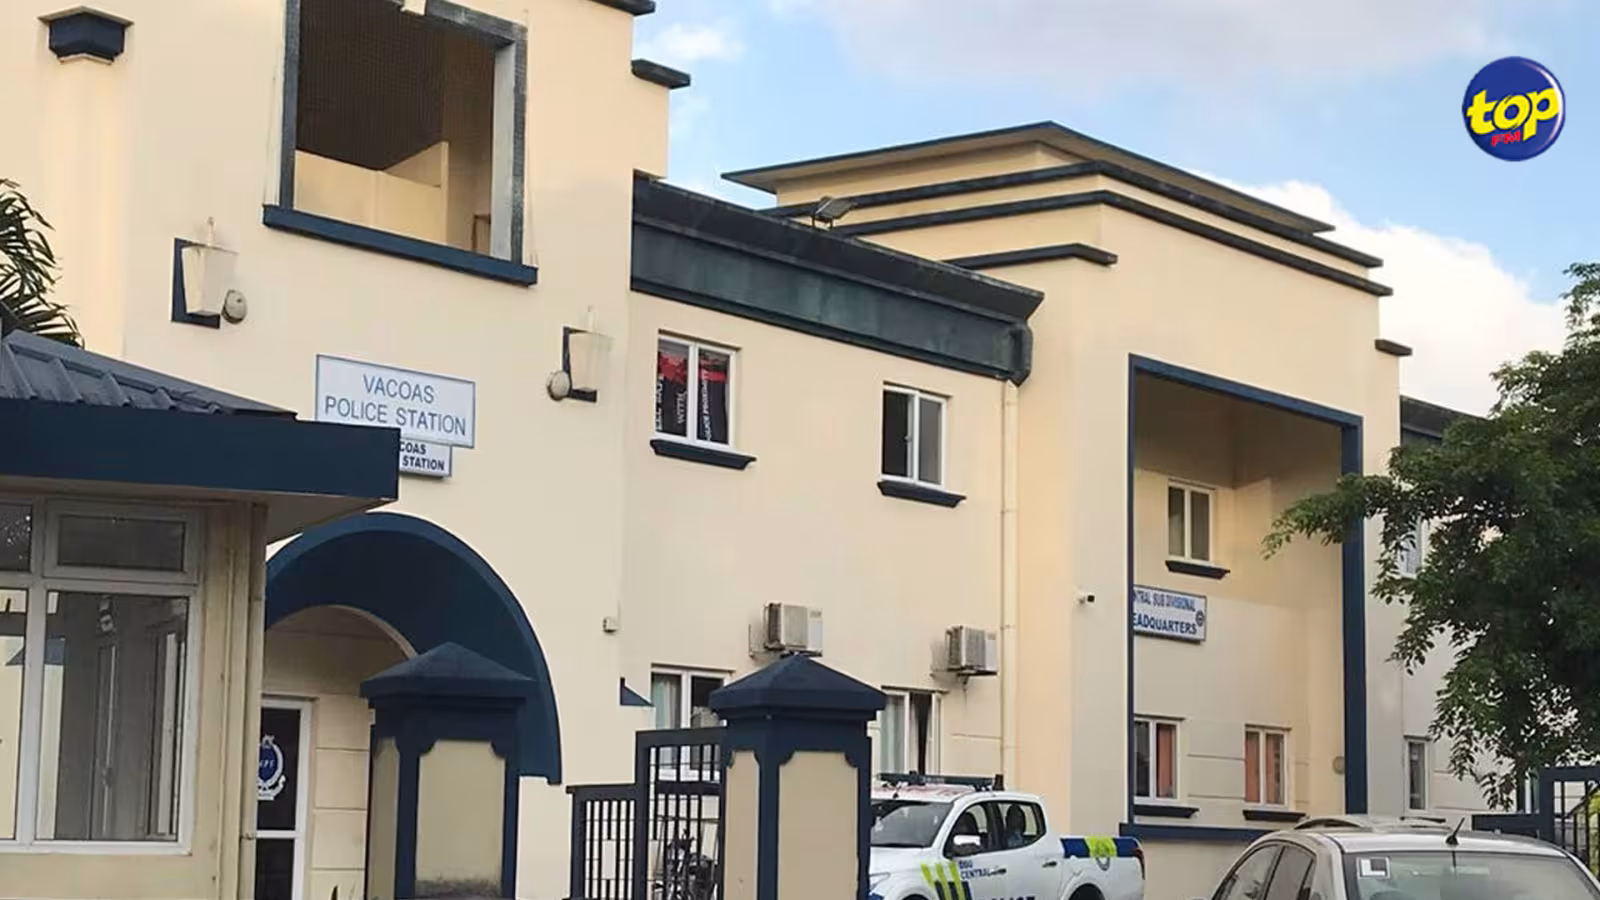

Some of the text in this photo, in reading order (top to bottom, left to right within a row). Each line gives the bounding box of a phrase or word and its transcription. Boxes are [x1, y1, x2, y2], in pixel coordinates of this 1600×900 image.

[363, 374, 434, 404] VACOAS
[325, 395, 466, 436] POLICE STATION
[399, 441, 426, 455] COAS
[402, 456, 445, 471] STATION
[1132, 612, 1197, 635] EADQUARTERS
